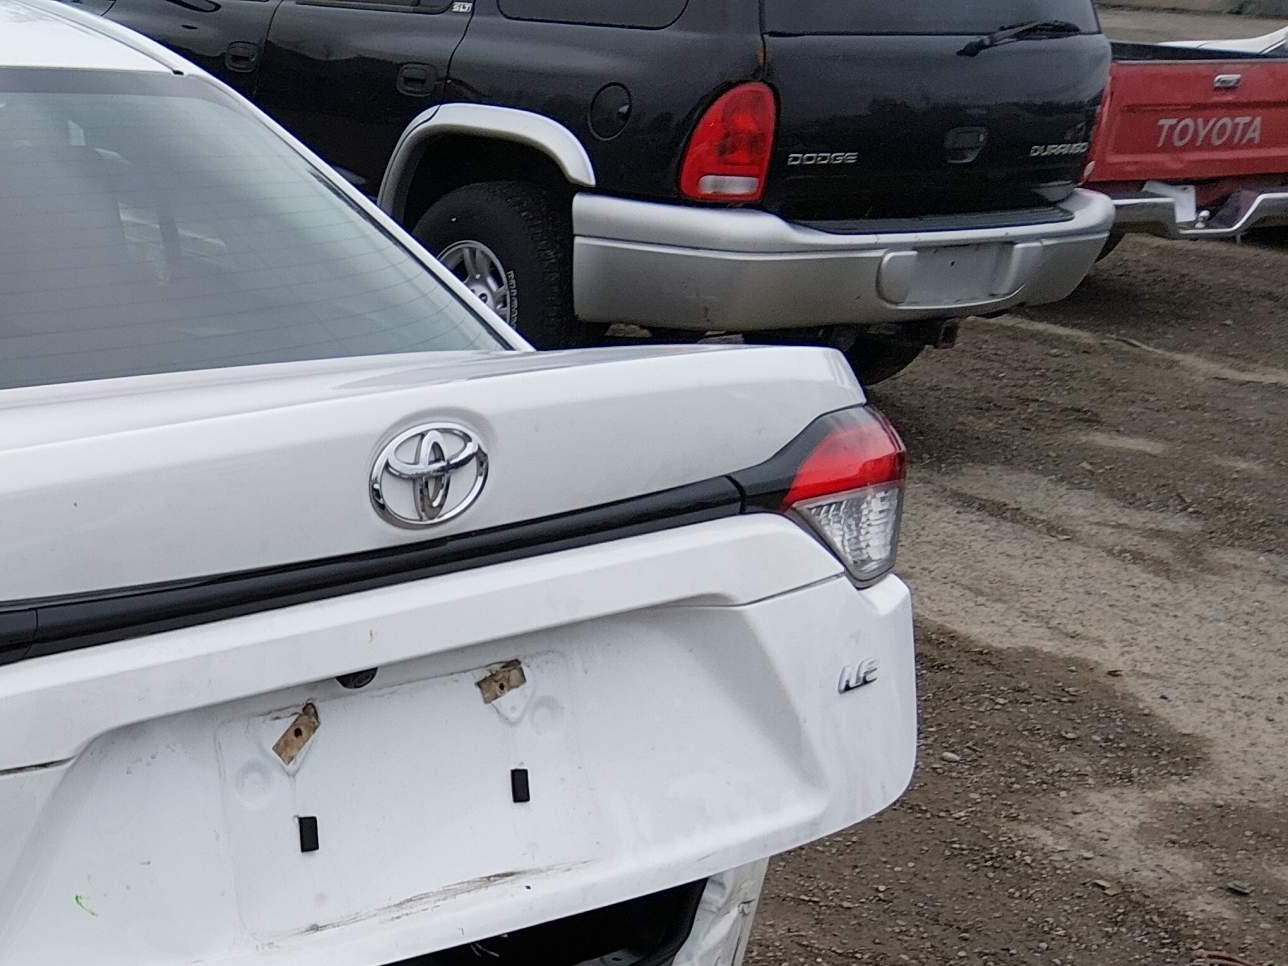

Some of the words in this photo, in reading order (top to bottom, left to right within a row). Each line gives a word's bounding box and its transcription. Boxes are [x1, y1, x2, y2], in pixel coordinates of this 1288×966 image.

[1157, 116, 1262, 147] TOYOTA
[787, 152, 859, 166] DODGE
[837, 657, 879, 694] LE
